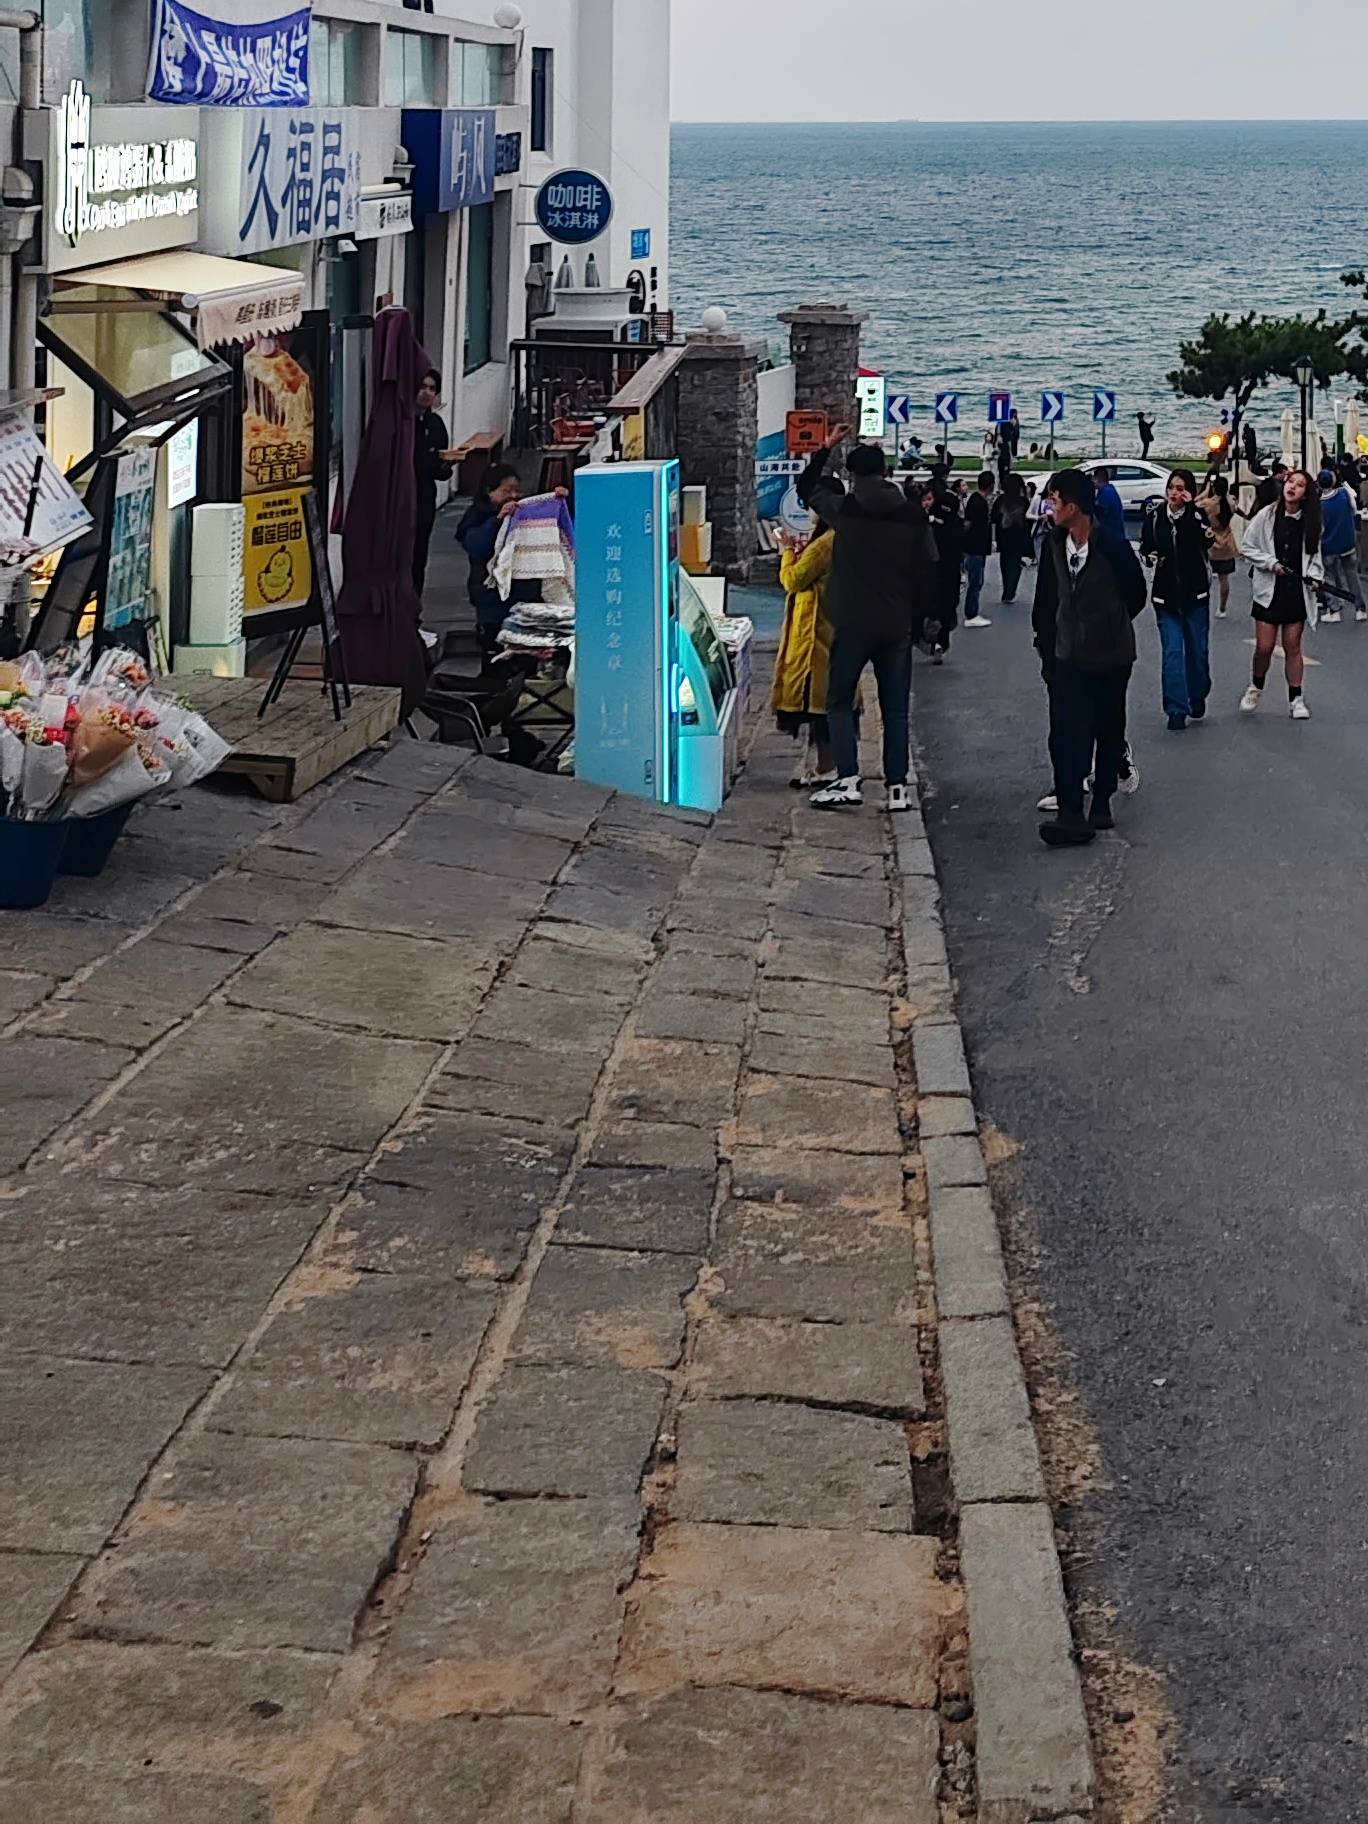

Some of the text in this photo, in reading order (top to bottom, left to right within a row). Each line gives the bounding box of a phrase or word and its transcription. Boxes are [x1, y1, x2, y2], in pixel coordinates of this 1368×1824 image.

[239, 116, 346, 242] 久福居
[547, 183, 602, 210] 咖啡
[546, 211, 600, 229] 冰淇淋
